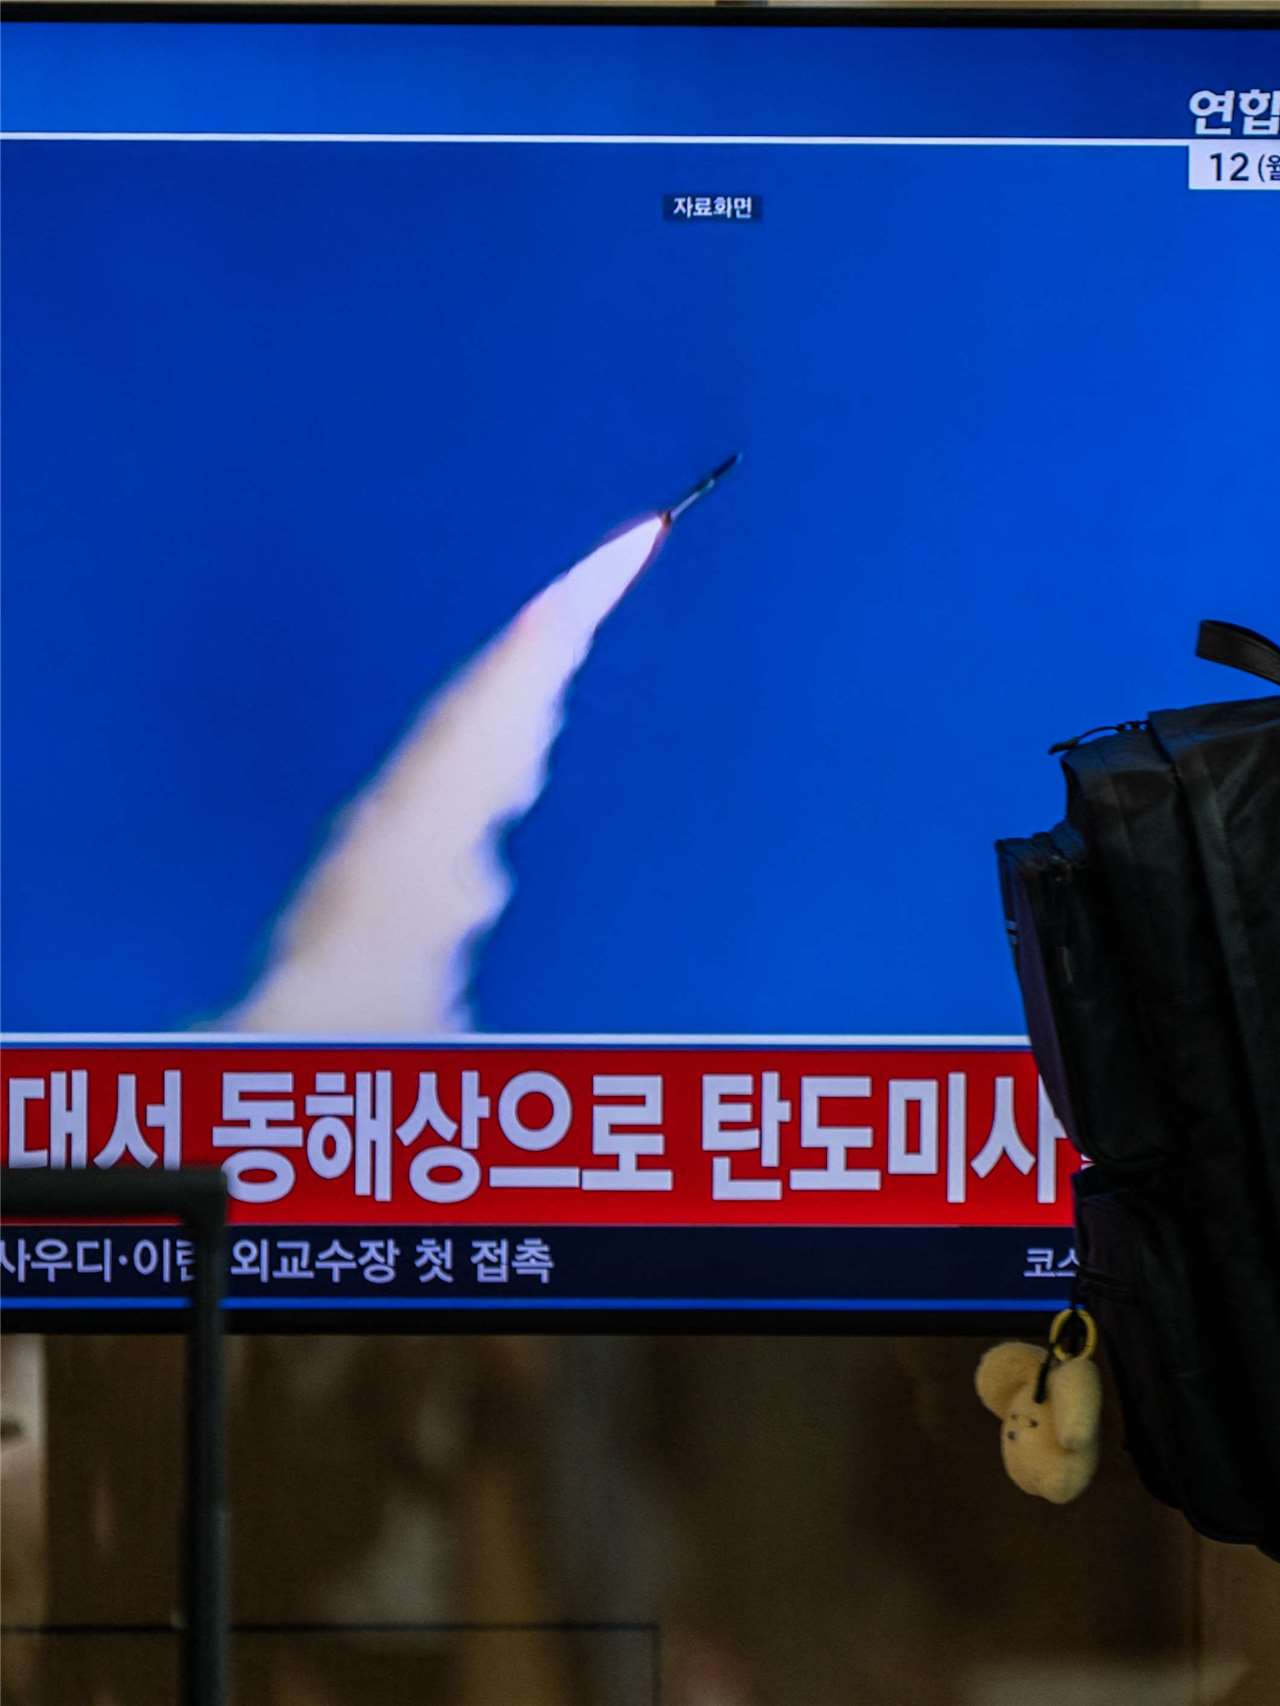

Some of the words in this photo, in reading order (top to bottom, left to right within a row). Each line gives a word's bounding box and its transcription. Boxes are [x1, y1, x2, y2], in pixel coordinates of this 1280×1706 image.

[673, 196, 752, 219] 자료화면
[212, 1070, 673, 1203] 동해상으로
[701, 1071, 1095, 1203] 탄도미사
[230, 1239, 400, 1283] 외교수장
[415, 1239, 454, 1283] 첫
[470, 1239, 555, 1283] 접촉
